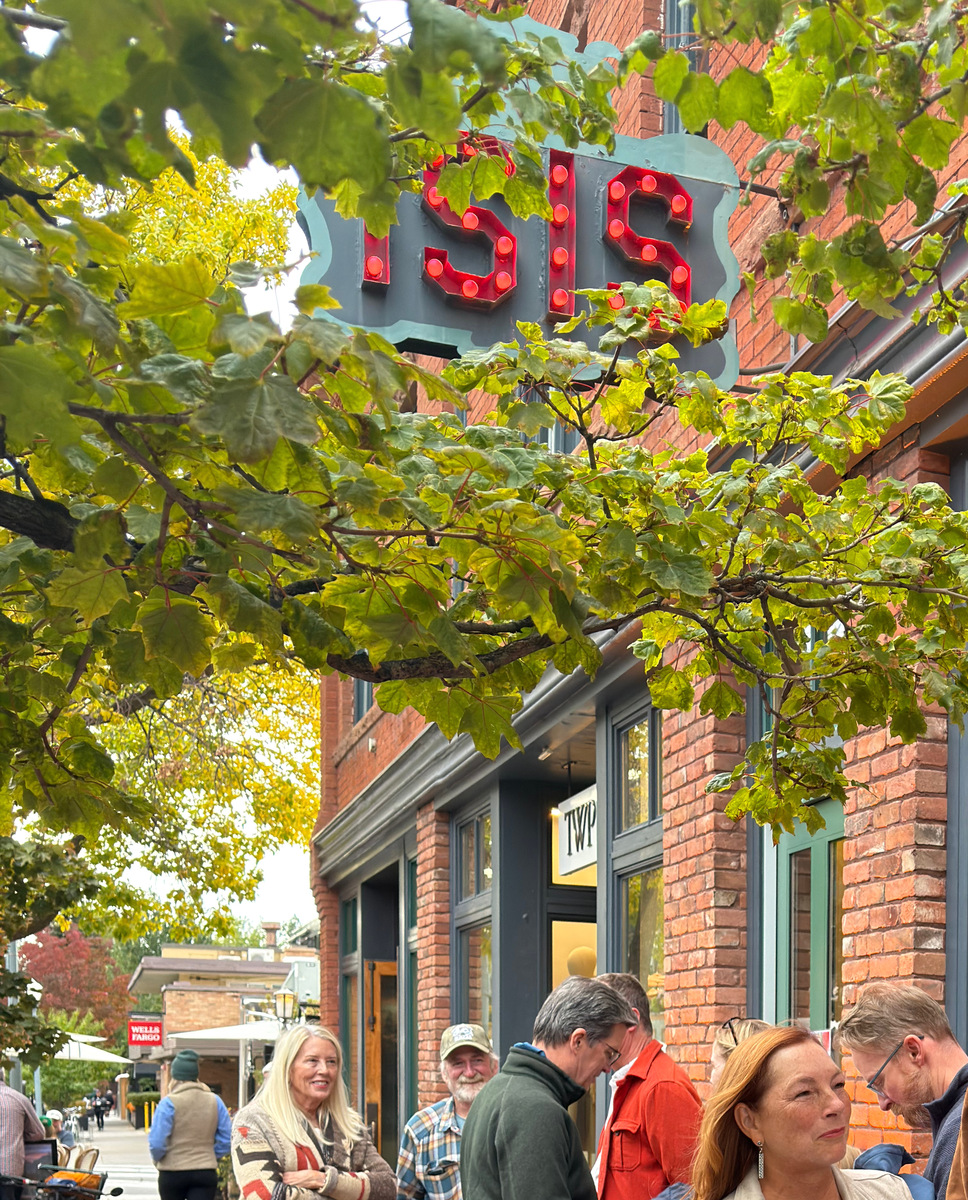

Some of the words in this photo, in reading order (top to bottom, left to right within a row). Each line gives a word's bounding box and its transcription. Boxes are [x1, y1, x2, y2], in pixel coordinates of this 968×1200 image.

[564, 799, 597, 856] TWP
[131, 1026, 160, 1034] WELLS
[132, 1034, 160, 1042] FARGO
